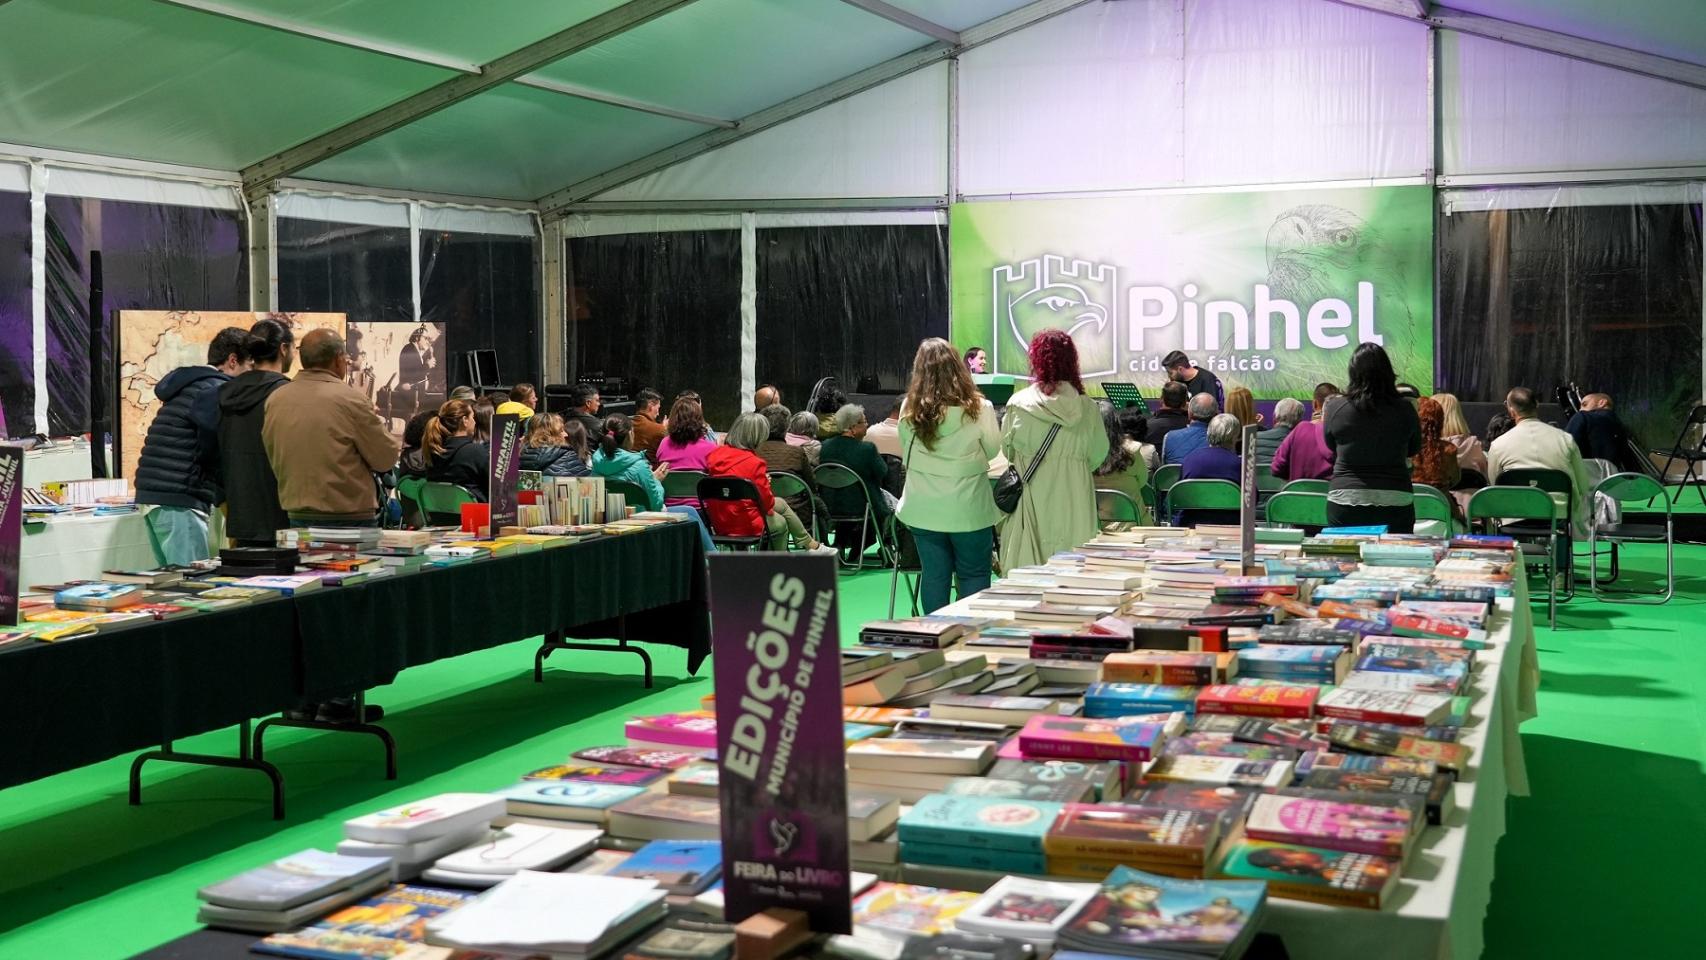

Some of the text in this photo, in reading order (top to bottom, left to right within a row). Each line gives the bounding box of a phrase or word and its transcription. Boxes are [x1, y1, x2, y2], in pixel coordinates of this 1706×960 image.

[1129, 282, 1383, 350] Pinhel
[1129, 355, 1276, 372] cide falcão
[495, 420, 513, 478] INFANTIL
[1, 459, 19, 499] JUVENIL
[724, 572, 806, 781] EDIÇÕES
[766, 588, 833, 795] MUNICÍPIO DE PINHEL
[734, 861, 777, 880] FEIRA
[796, 867, 842, 887] LIVRO
